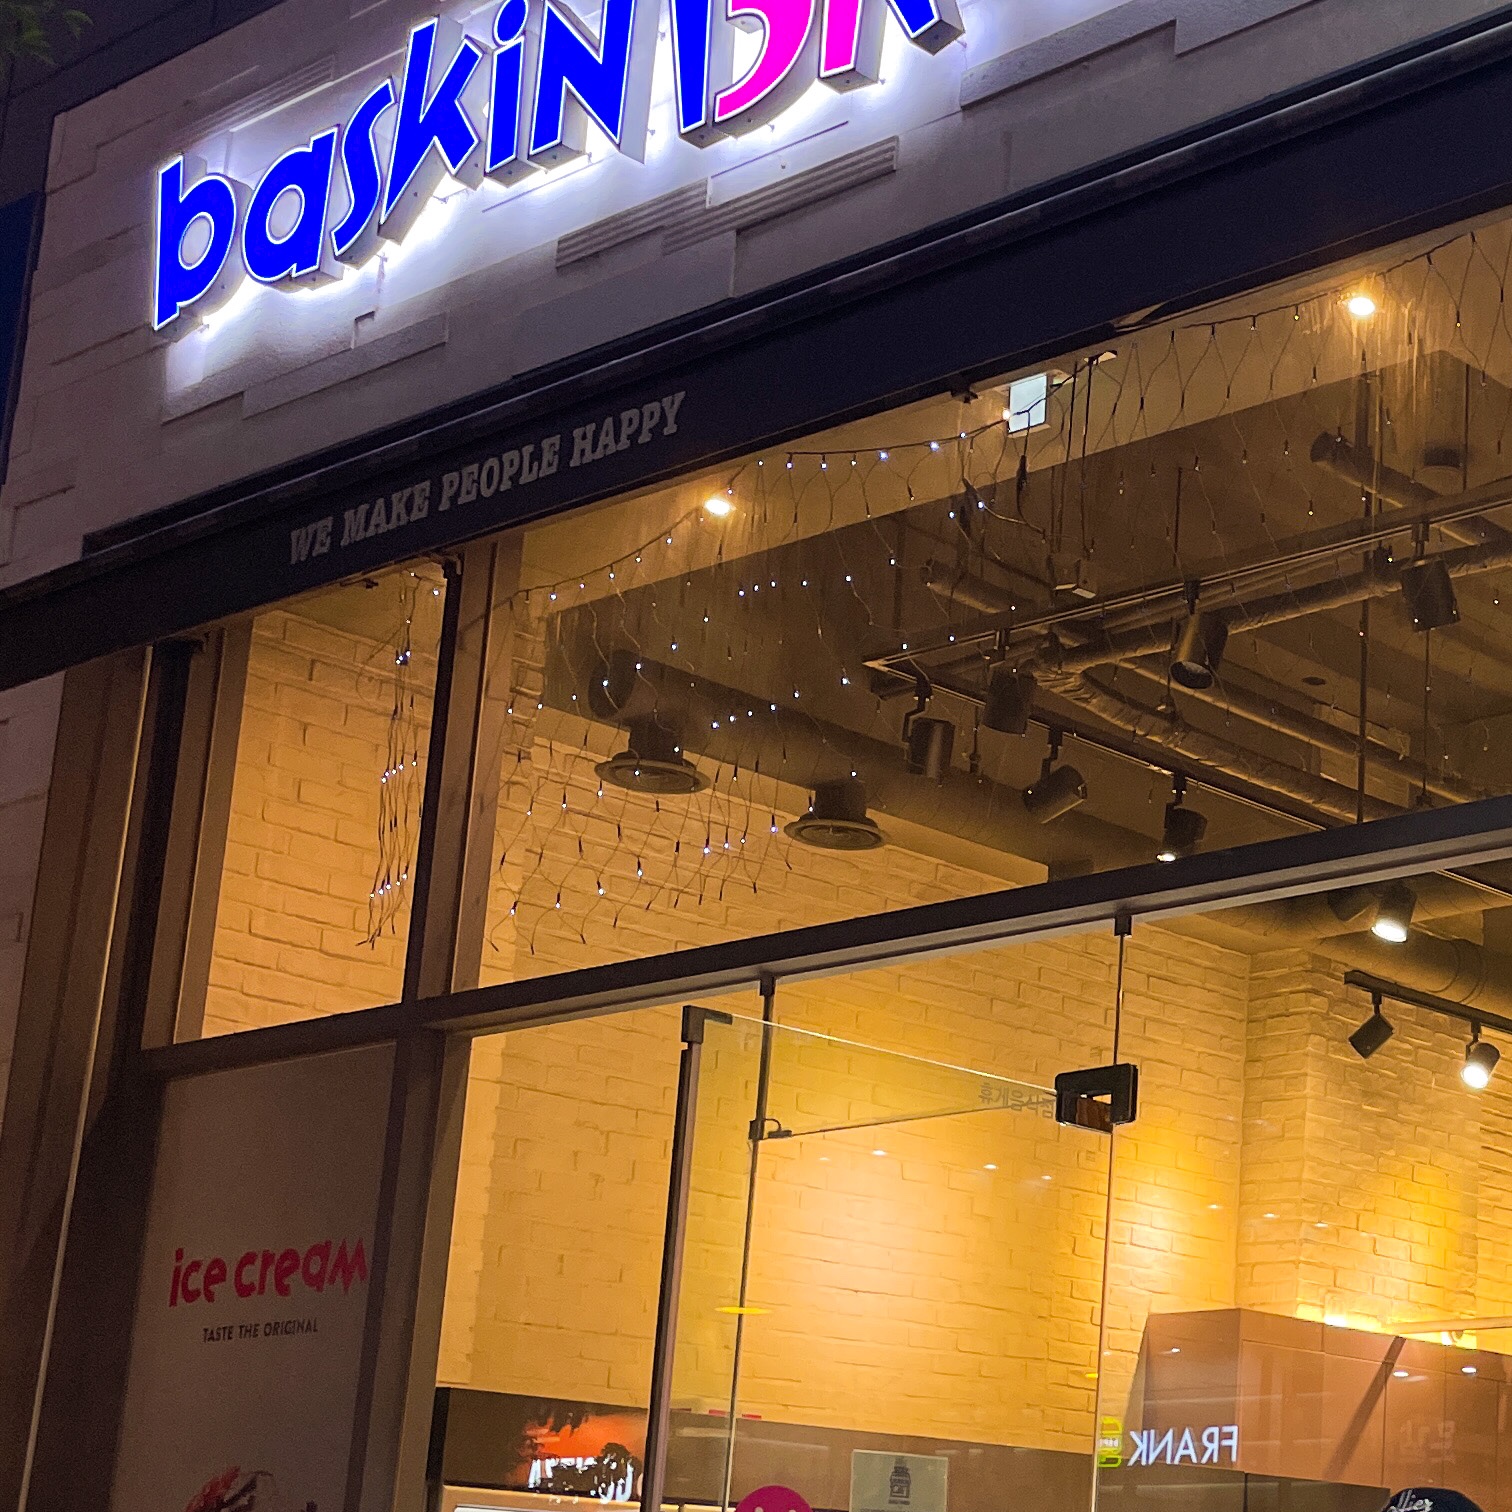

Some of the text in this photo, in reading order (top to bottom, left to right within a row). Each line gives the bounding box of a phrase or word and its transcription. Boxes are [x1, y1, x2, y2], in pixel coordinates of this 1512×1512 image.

[290, 391, 687, 564] WE MAKE PEOPLE HAPPY
[168, 1248, 228, 1308] ice
[203, 1318, 319, 1343] TASTE THE ORIGINAL
